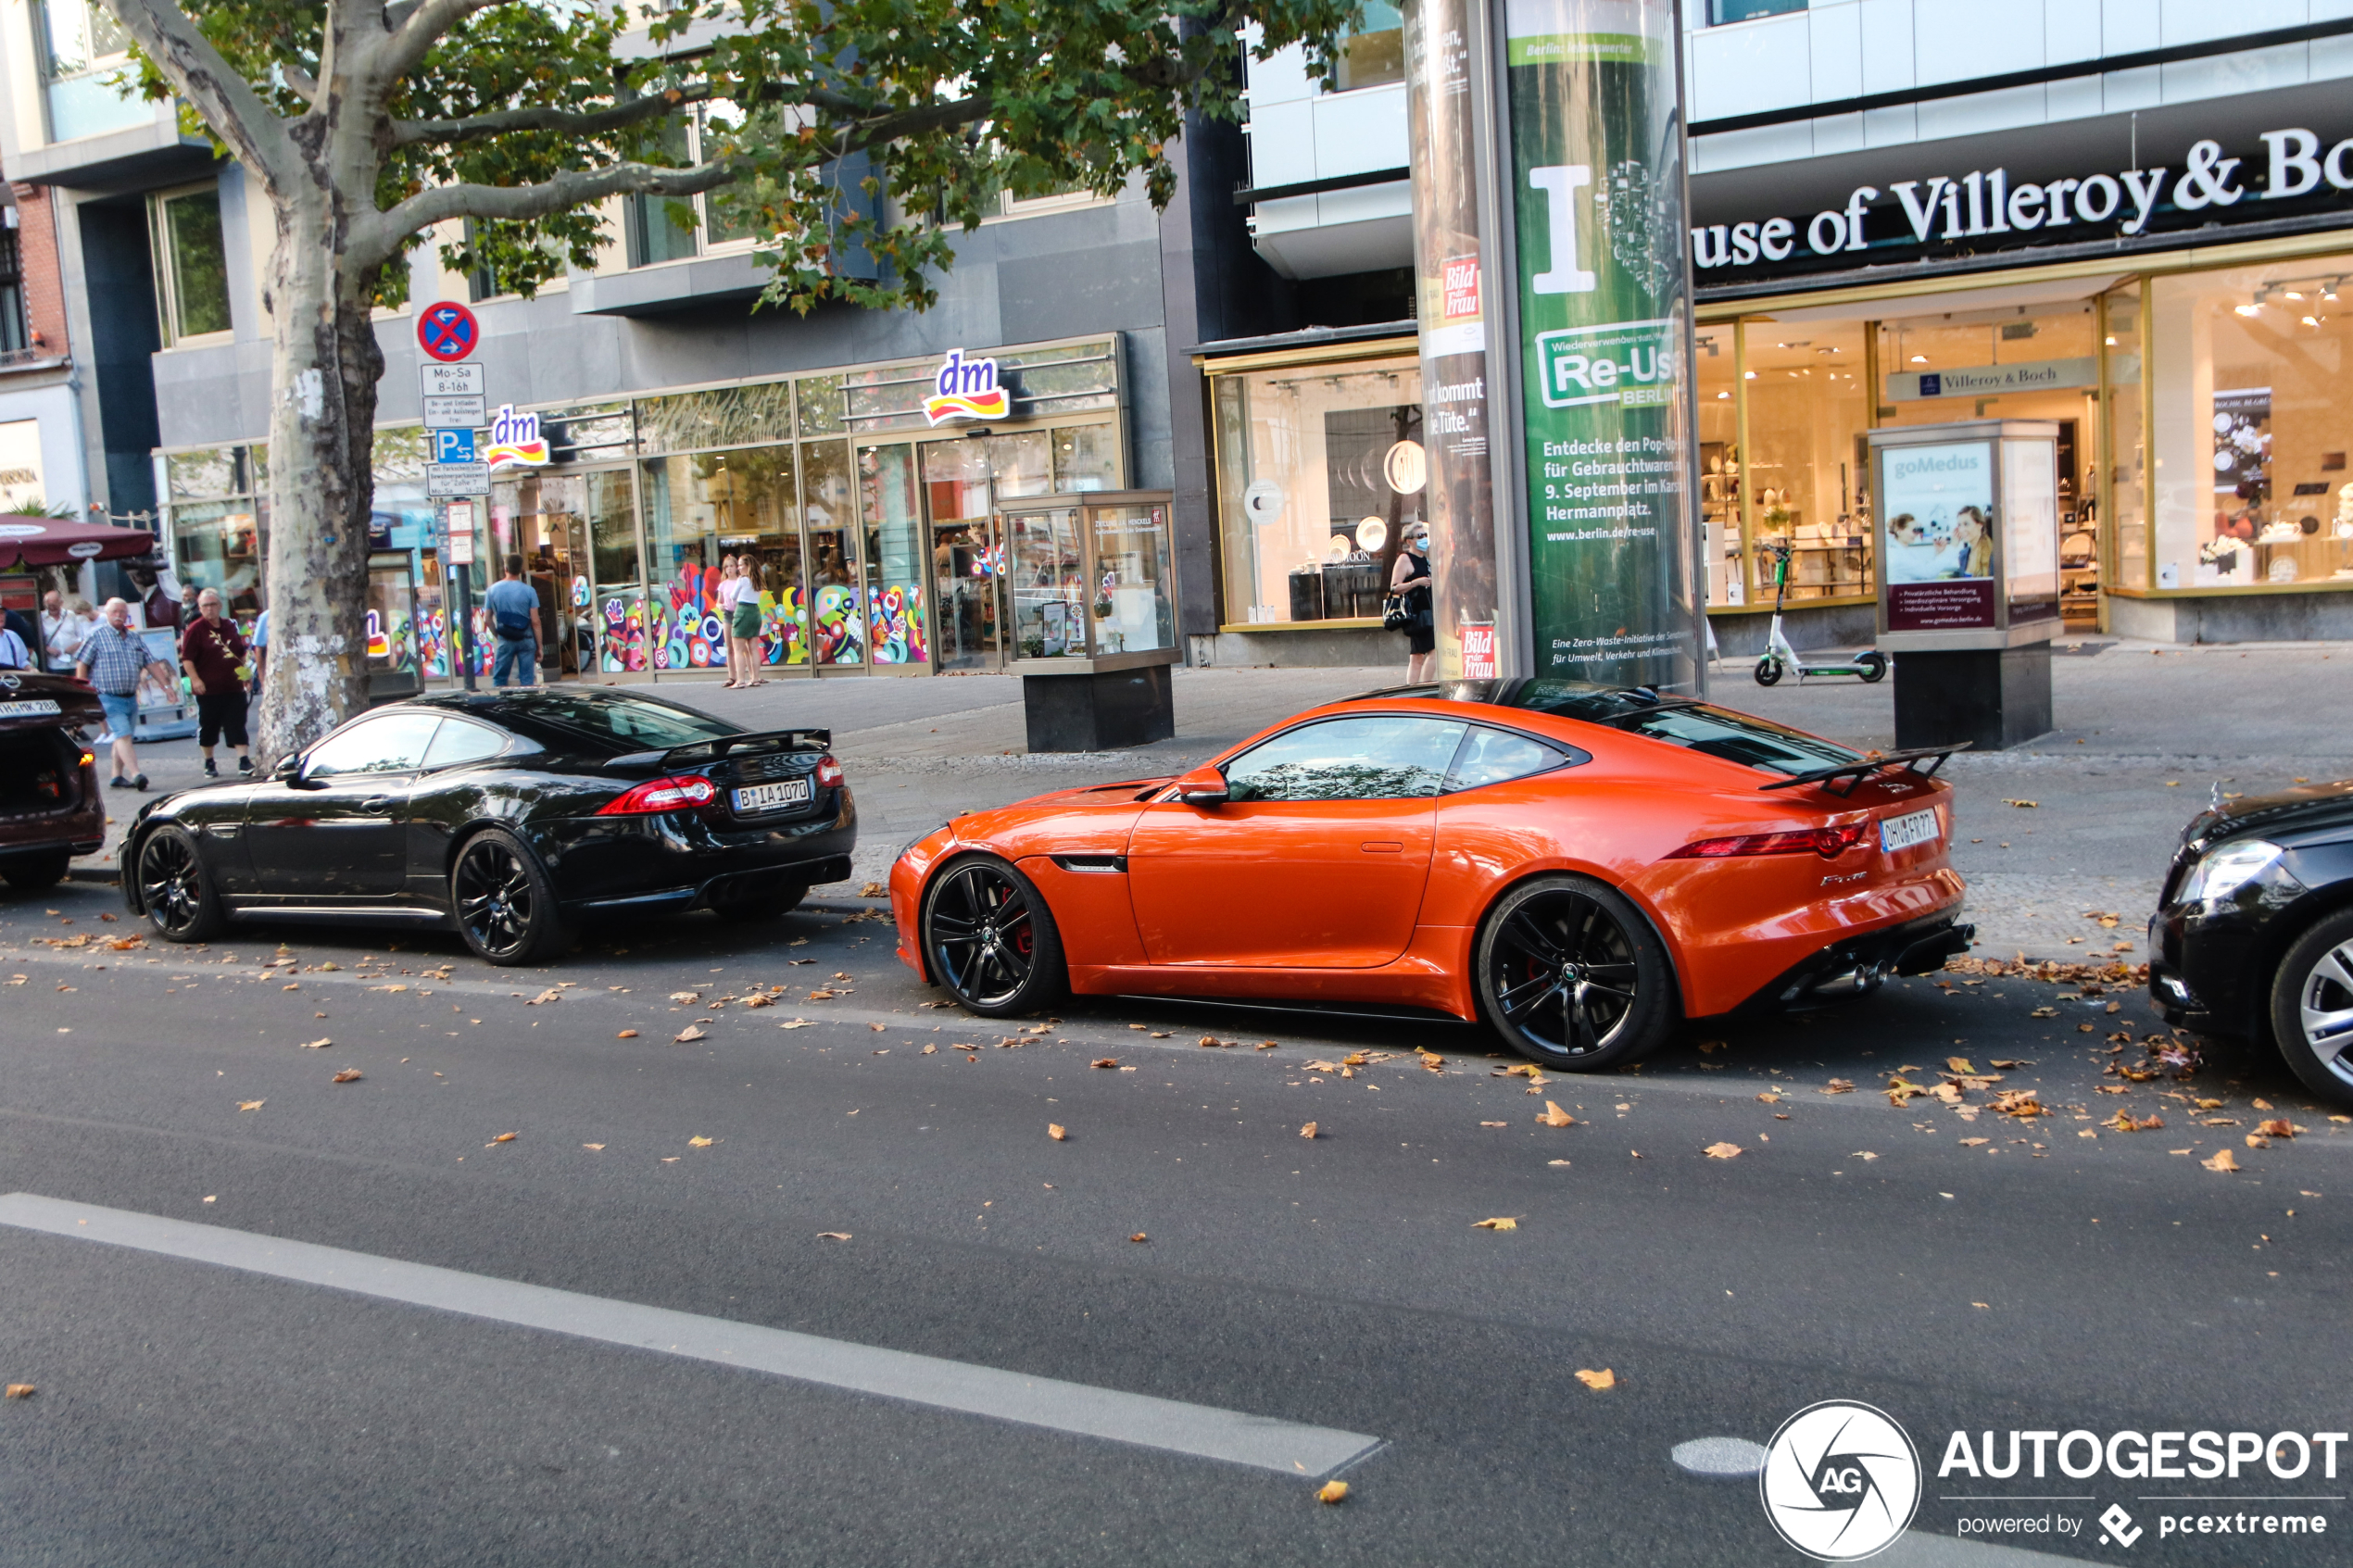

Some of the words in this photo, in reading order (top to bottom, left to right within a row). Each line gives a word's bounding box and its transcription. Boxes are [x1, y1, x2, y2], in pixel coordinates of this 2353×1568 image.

[1527, 42, 1563, 56] Berlin:
[1691, 216, 1795, 269] use
[1807, 185, 1879, 256] of
[1890, 167, 2166, 243] Villeroy
[2172, 139, 2244, 210] &
[2259, 128, 2353, 200] Bo
[1529, 165, 1595, 295] I
[1445, 263, 1476, 291] Bild
[1446, 292, 1477, 316] Frau
[1552, 335, 1636, 352] Wiederverwenden
[434, 368, 471, 378] Mo-Sa
[939, 353, 993, 396] dm
[1554, 345, 1673, 392] Re-Us
[1945, 374, 2001, 387] Villeroy
[2006, 372, 2014, 383] &
[2020, 368, 2057, 382] Boch
[438, 383, 469, 392] 8-16h
[1437, 377, 1484, 403] kommt
[496, 408, 535, 445] dm
[439, 432, 459, 458] P
[1543, 438, 1612, 457] Entdecke
[1616, 437, 1640, 452] den
[1544, 462, 1568, 478] für
[1572, 457, 1673, 477] Gebrauchtwaren
[1894, 455, 1979, 479] goMedus
[1545, 484, 1560, 499] 9.
[1565, 479, 1641, 500] September
[1644, 479, 1657, 494] im
[1127, 517, 1151, 525] HENCKELS
[1546, 501, 1652, 521] Hermannplatz.
[1547, 525, 1655, 541] www.berlin.de/re-use
[1944, 587, 1977, 596] Behandlung
[1949, 596, 1982, 604] Versorgung
[1463, 631, 1493, 654] Bild
[1552, 638, 1570, 649] Eine
[1573, 633, 1655, 647] Zero-Waste-Initiative
[1656, 631, 1666, 641] der
[1464, 654, 1493, 678] Frau
[1473, 653, 1484, 661] der
[1552, 652, 1567, 665] für
[1567, 652, 1603, 663] Umwelt,
[1605, 649, 1635, 660] Verkehr
[1637, 647, 1650, 658] und
[19, 701, 37, 712] MK
[741, 790, 750, 807] B
[760, 786, 775, 804] IA
[776, 782, 807, 801] 1070
